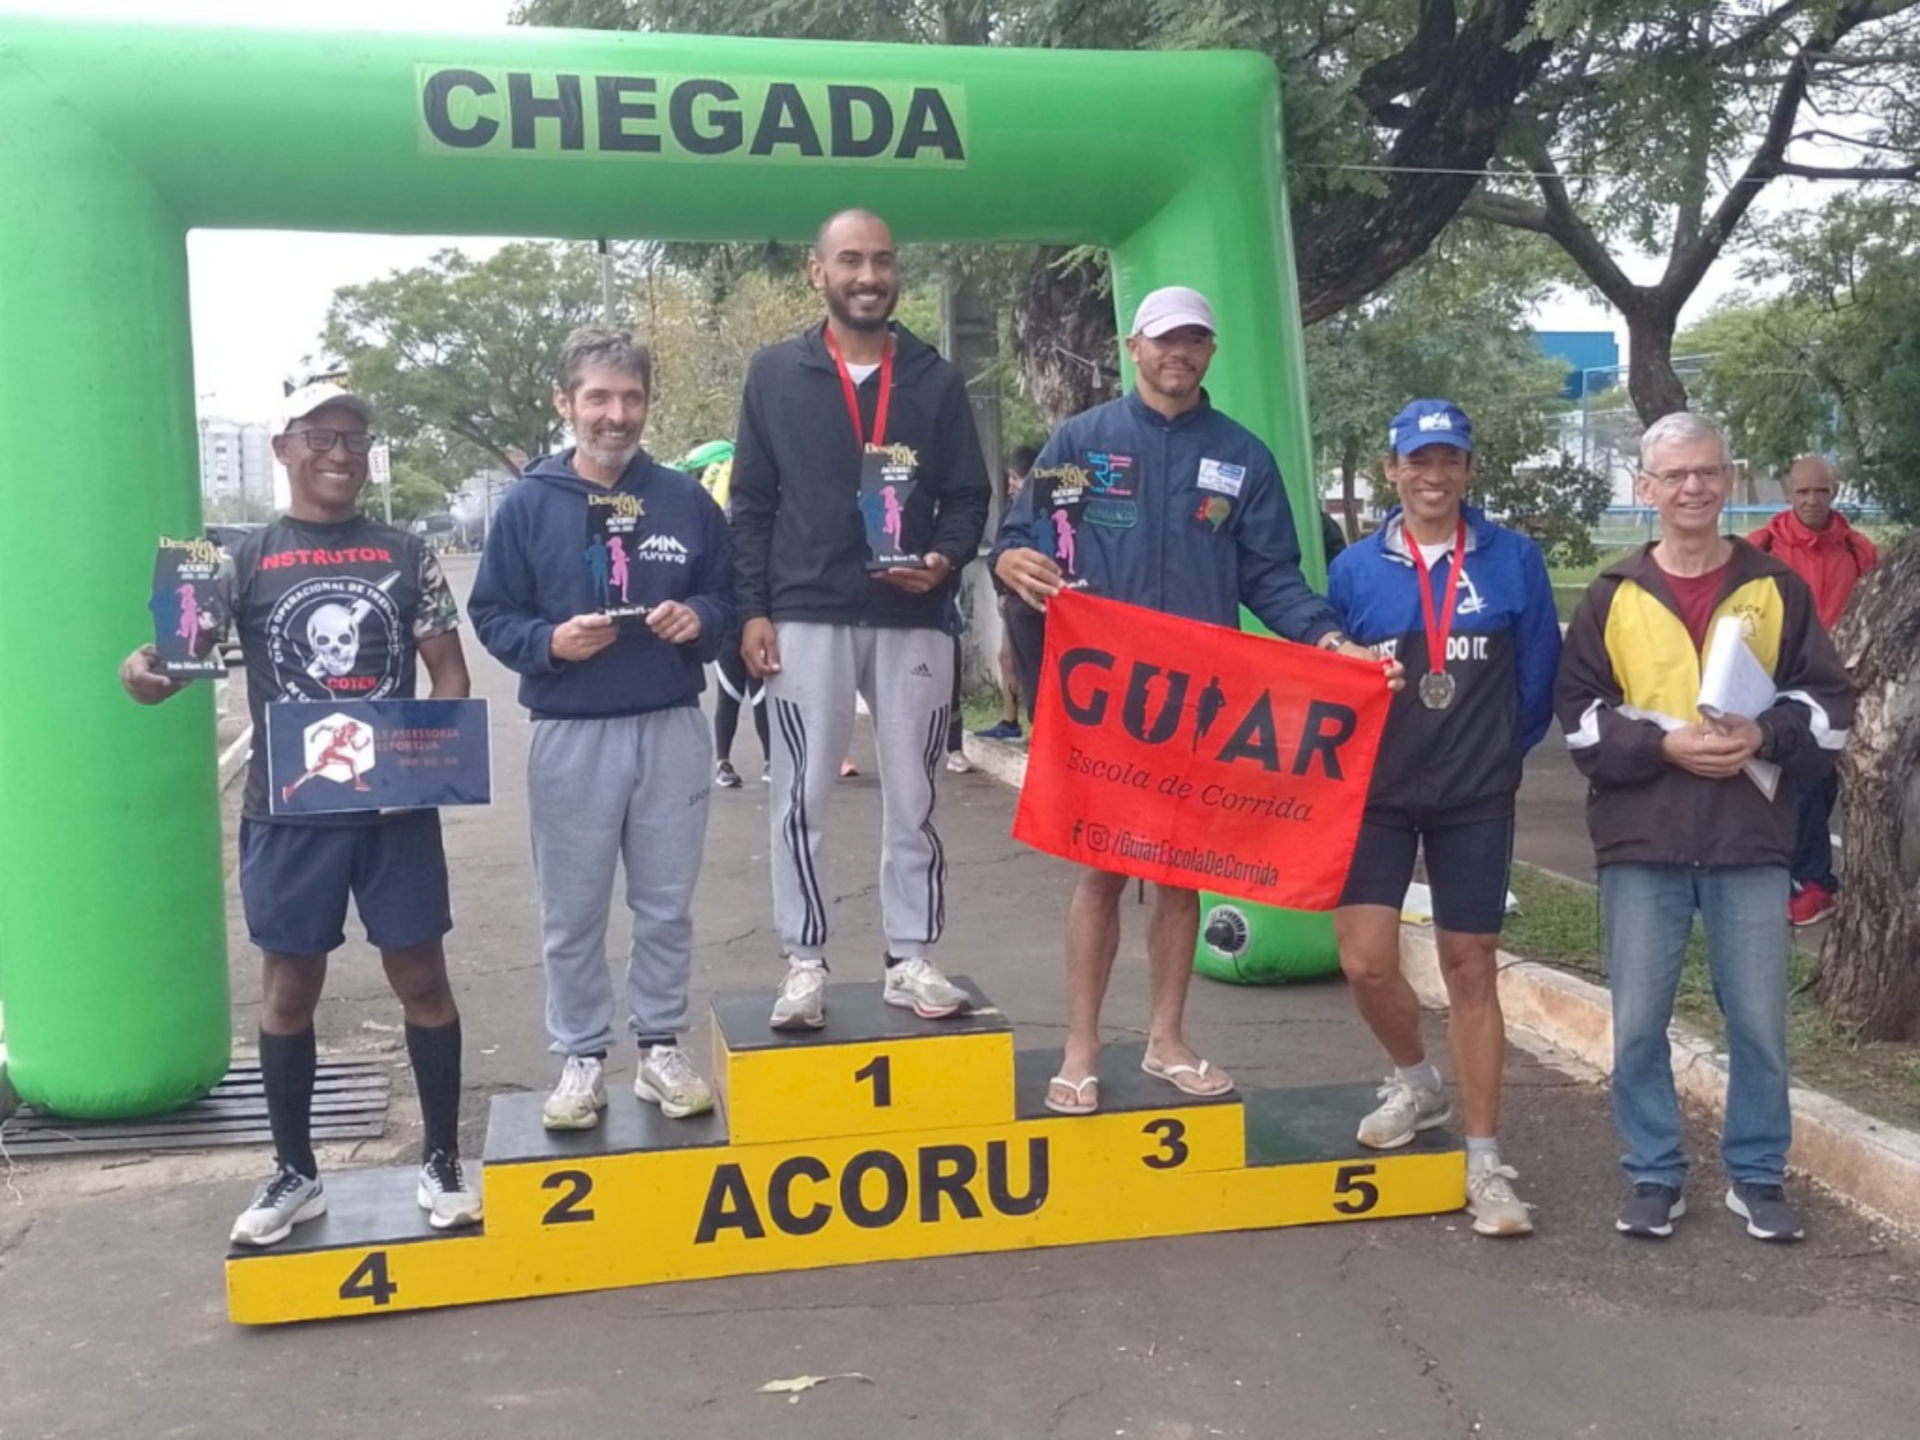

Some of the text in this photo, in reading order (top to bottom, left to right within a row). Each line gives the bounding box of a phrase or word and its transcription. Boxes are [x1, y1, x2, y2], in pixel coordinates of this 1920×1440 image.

[422, 69, 965, 160] CHEGADA
[639, 551, 687, 564] running
[274, 581, 345, 623] OPERACIONAL
[347, 582, 365, 594] DE
[1446, 637, 1469, 660] DO
[391, 728, 459, 739] ASSESSORIA
[1058, 646, 1358, 780] GUIAR
[376, 740, 440, 751] ESPORTIVA
[1066, 747, 1313, 823] Escola de Corrida
[1111, 828, 1280, 888] /GuiarEscolaDeCorrida
[854, 1055, 892, 1108] 1
[1140, 1118, 1189, 1169] 3
[541, 1170, 595, 1225] 2
[693, 1136, 1051, 1246] ACORU
[1332, 1163, 1379, 1215] 5
[338, 1251, 398, 1306] 4
